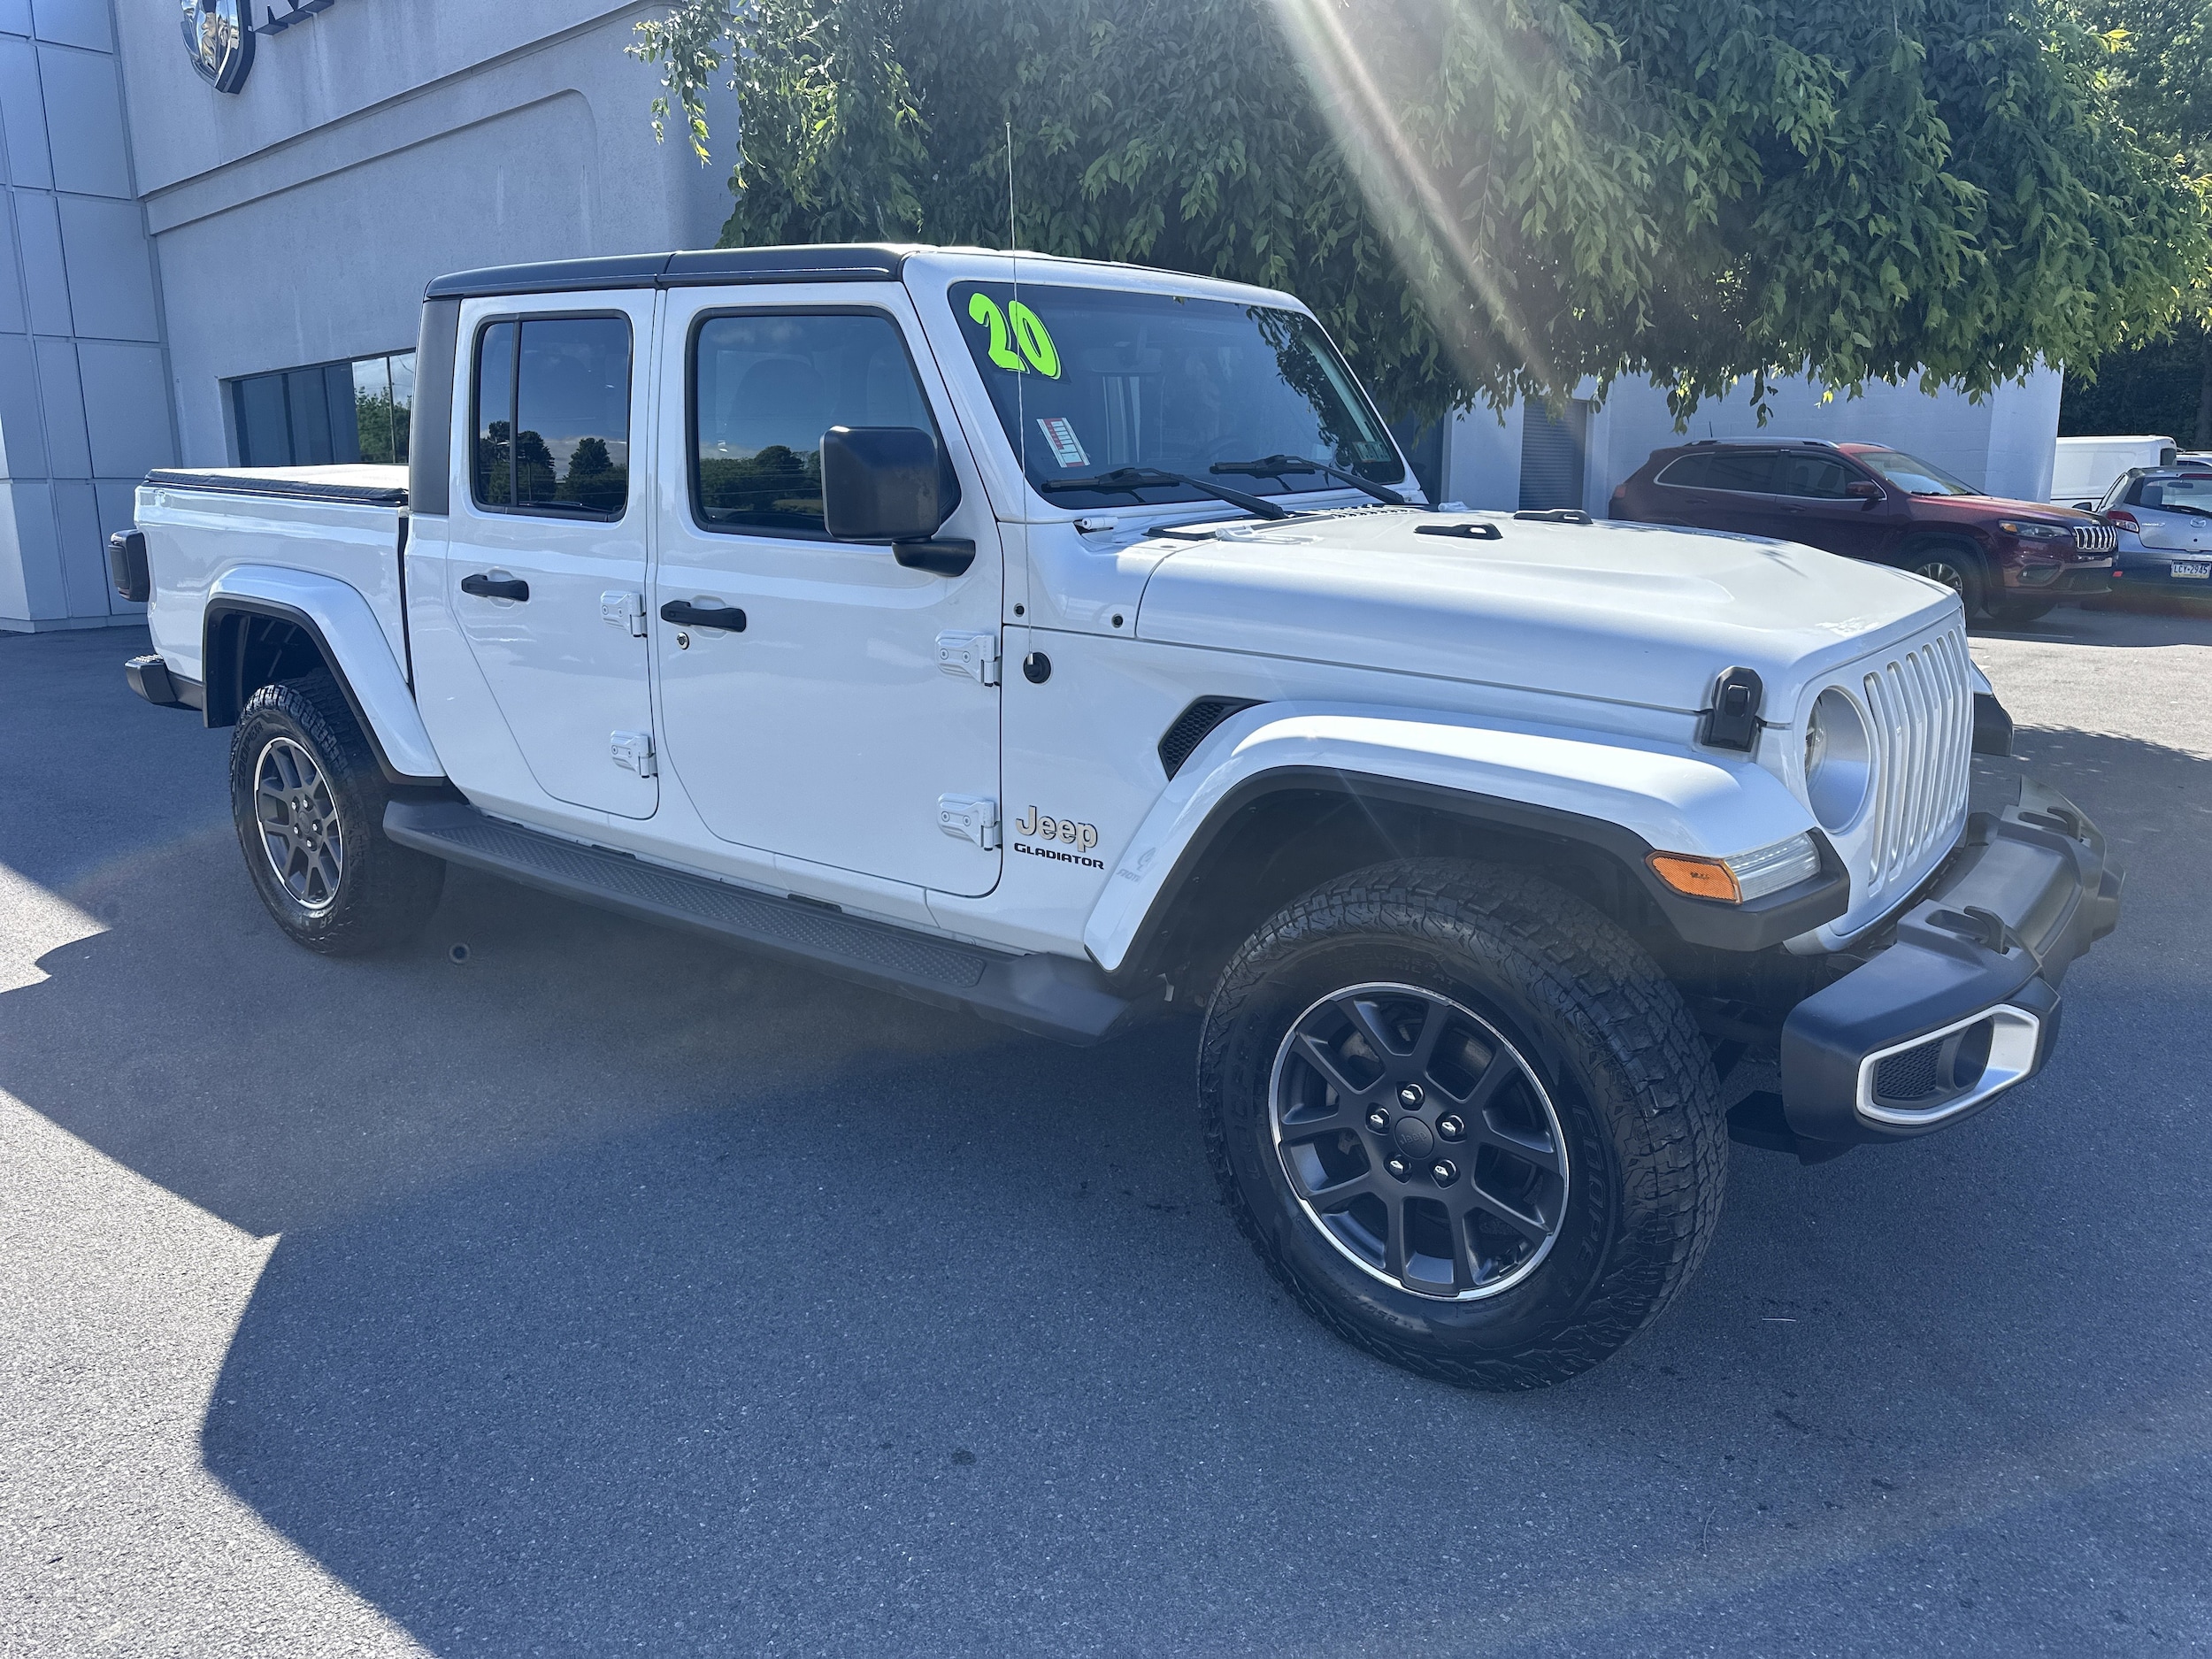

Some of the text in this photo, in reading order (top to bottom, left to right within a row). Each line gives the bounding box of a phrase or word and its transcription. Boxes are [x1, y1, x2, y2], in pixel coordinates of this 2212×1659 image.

[968, 292, 1062, 380] 20
[1015, 804, 1098, 853] Jeep
[1013, 842, 1105, 871] GLADIATOR
